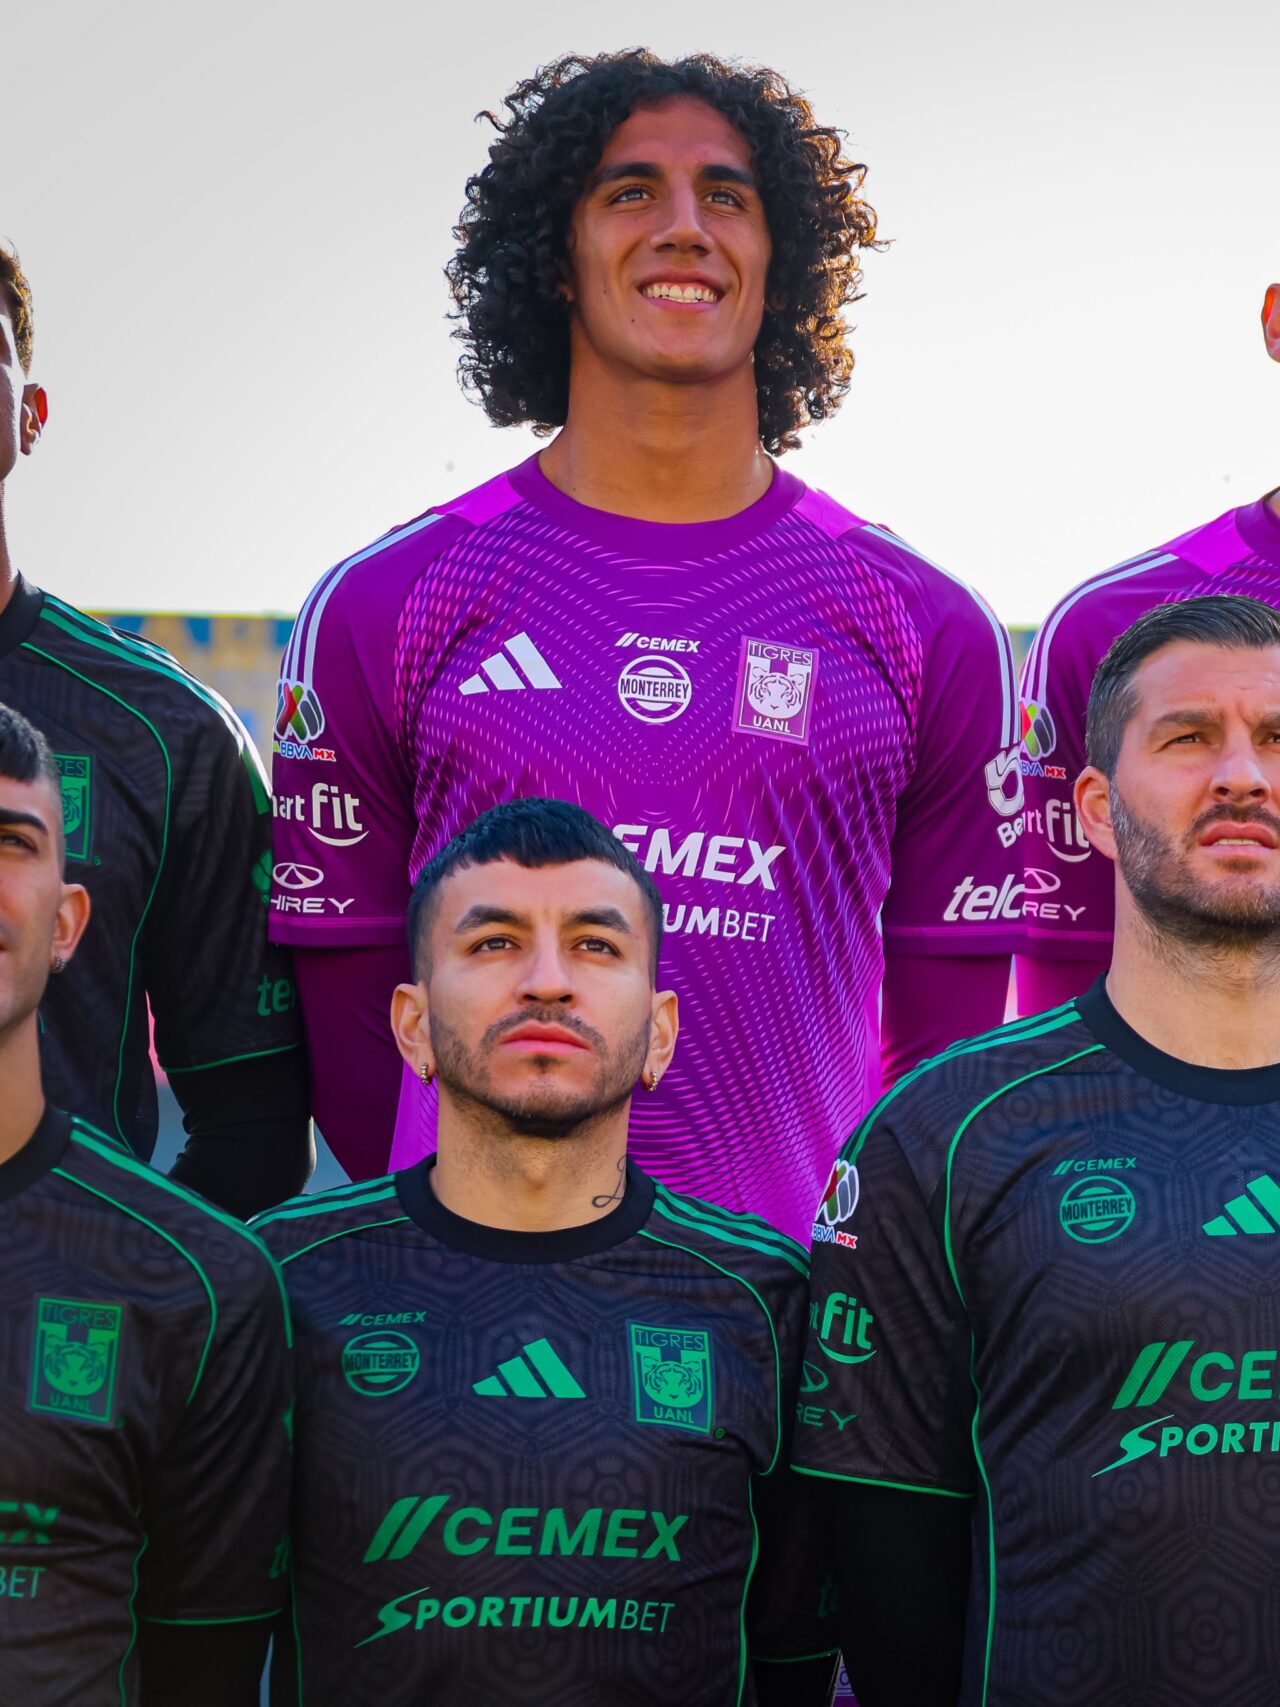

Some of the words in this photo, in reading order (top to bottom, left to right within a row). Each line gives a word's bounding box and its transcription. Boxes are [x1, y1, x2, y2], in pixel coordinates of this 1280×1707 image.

[637, 636, 701, 653] CEMEX
[750, 642, 812, 665] TIGRES
[620, 678, 689, 699] MONTERREY
[753, 715, 791, 733] UANL
[280, 741, 313, 760] BBVA
[312, 747, 337, 762] MX
[1044, 765, 1067, 779] MX
[312, 783, 362, 831] fit
[257, 974, 295, 1016] te
[1073, 1157, 1136, 1172] CEMEX
[1061, 1197, 1132, 1222] MONTERREY
[836, 1231, 858, 1249] MX
[44, 1304, 116, 1329] TIGRES
[361, 1311, 427, 1326] CEMEX
[821, 1292, 873, 1350] fit
[636, 1330, 705, 1351] TIGRES
[344, 1352, 418, 1370] MONTERREY
[49, 1392, 93, 1413] UANL
[654, 1406, 695, 1423] UANL
[443, 1506, 689, 1562] CEMEX
[352, 1586, 675, 1649] SPORTIUMBET
